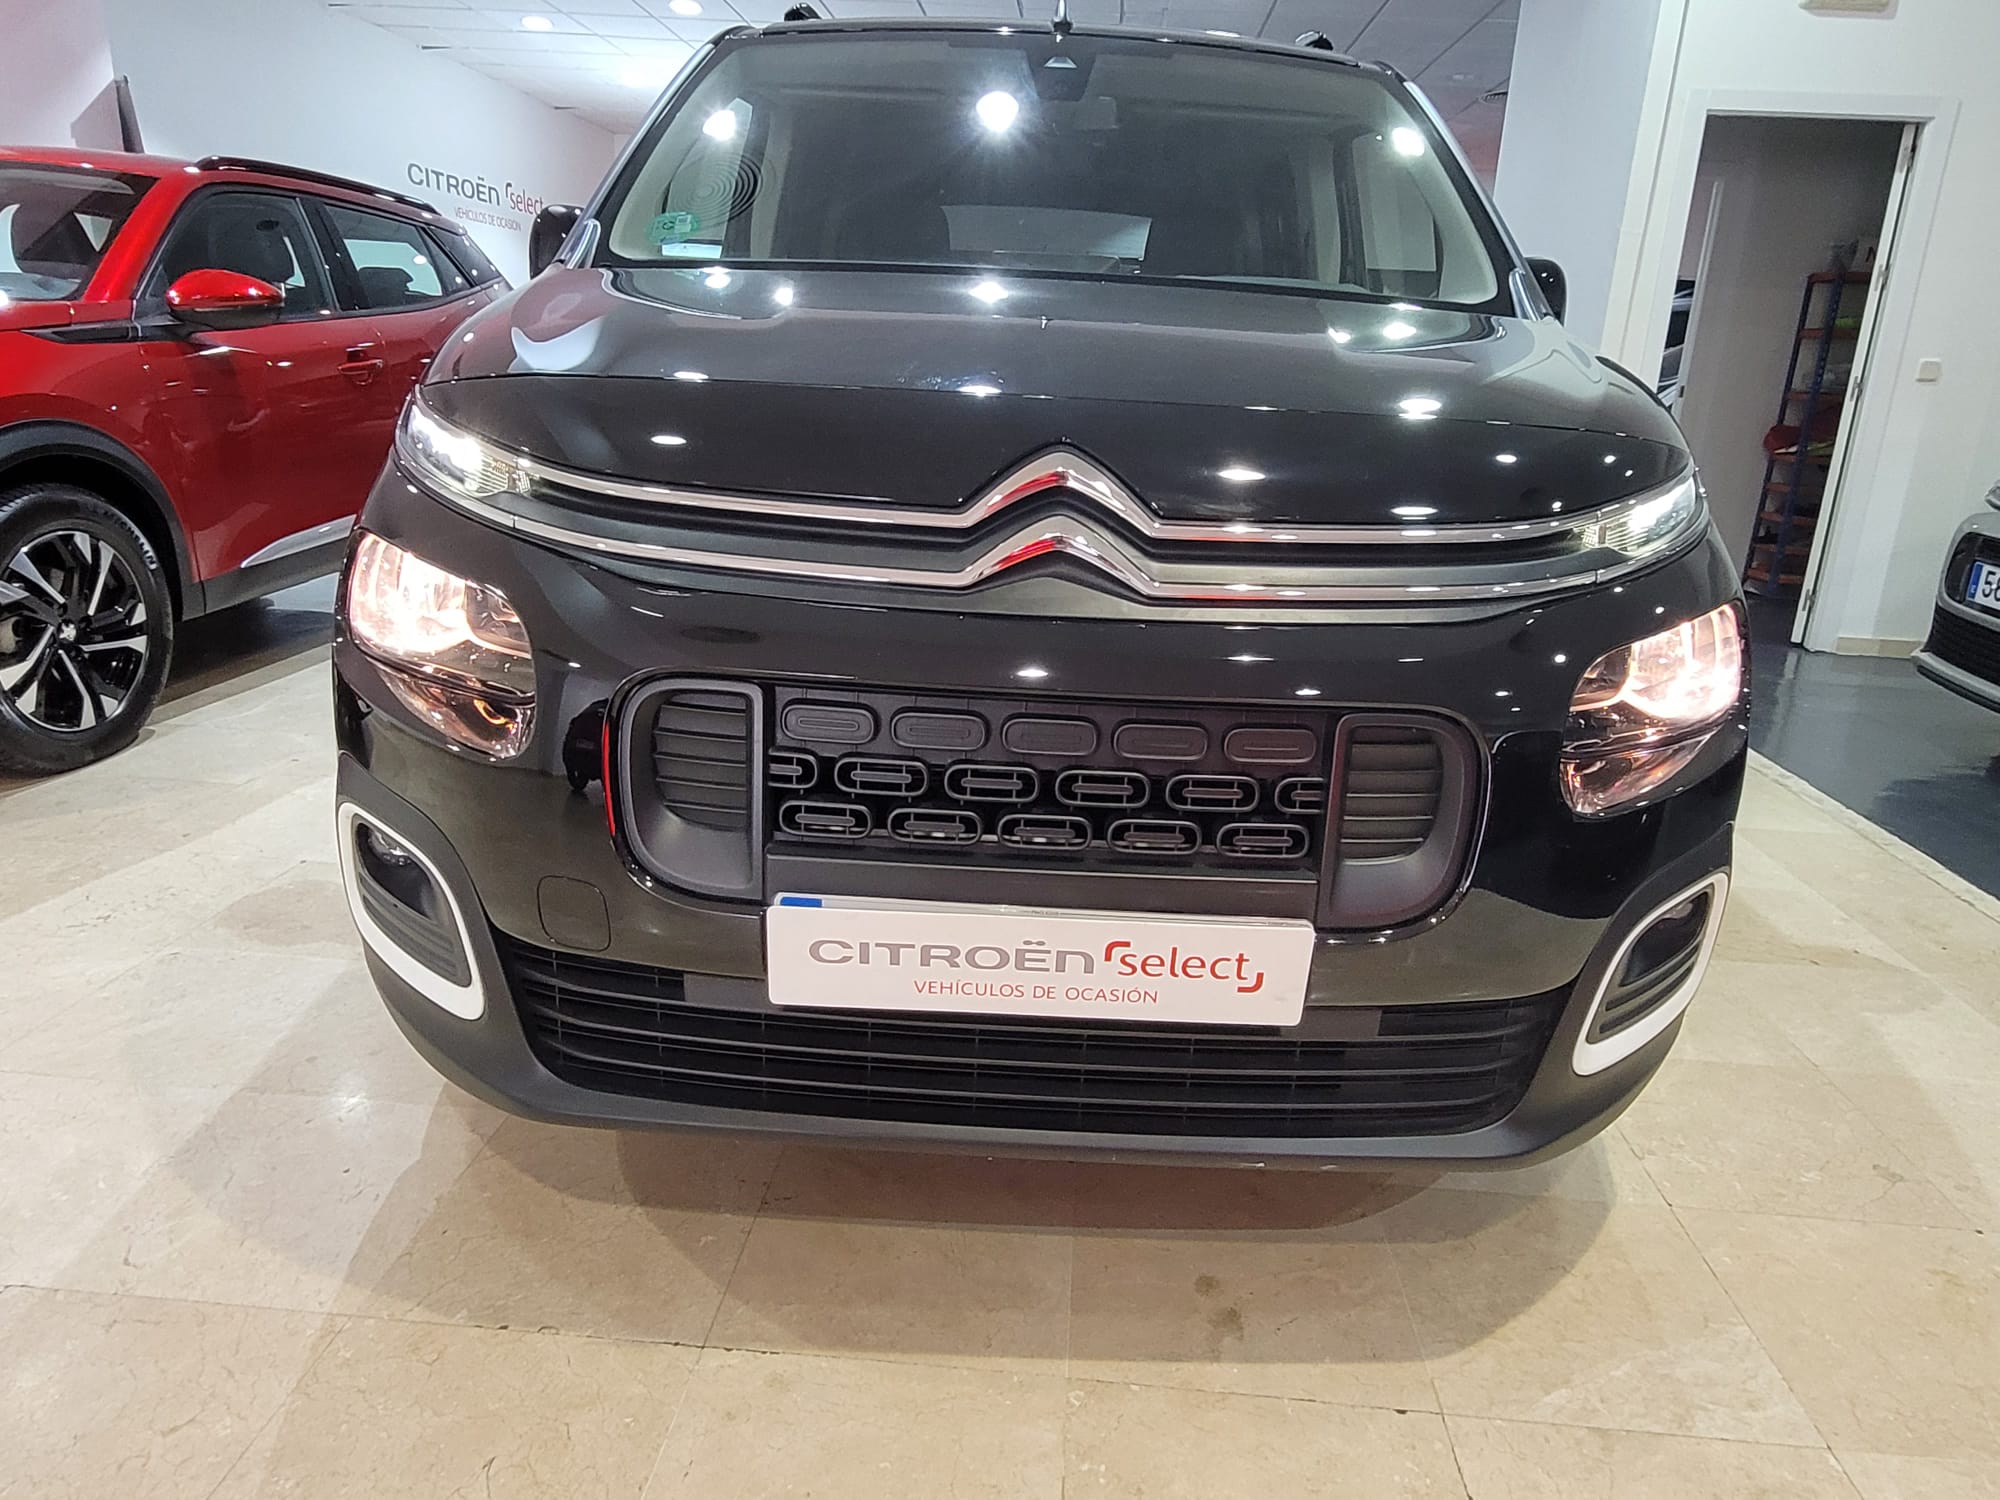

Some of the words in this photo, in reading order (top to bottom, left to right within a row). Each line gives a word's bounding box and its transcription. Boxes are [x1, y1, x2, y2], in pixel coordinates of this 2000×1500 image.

[408, 163, 500, 206] CITROËN
[808, 939, 1095, 974] CITROËN
[1117, 946, 1250, 981] select
[914, 979, 1025, 998] VEHÍCULOS
[1033, 985, 1056, 1000] DE
[1065, 986, 1158, 1003] OCASIÓN
